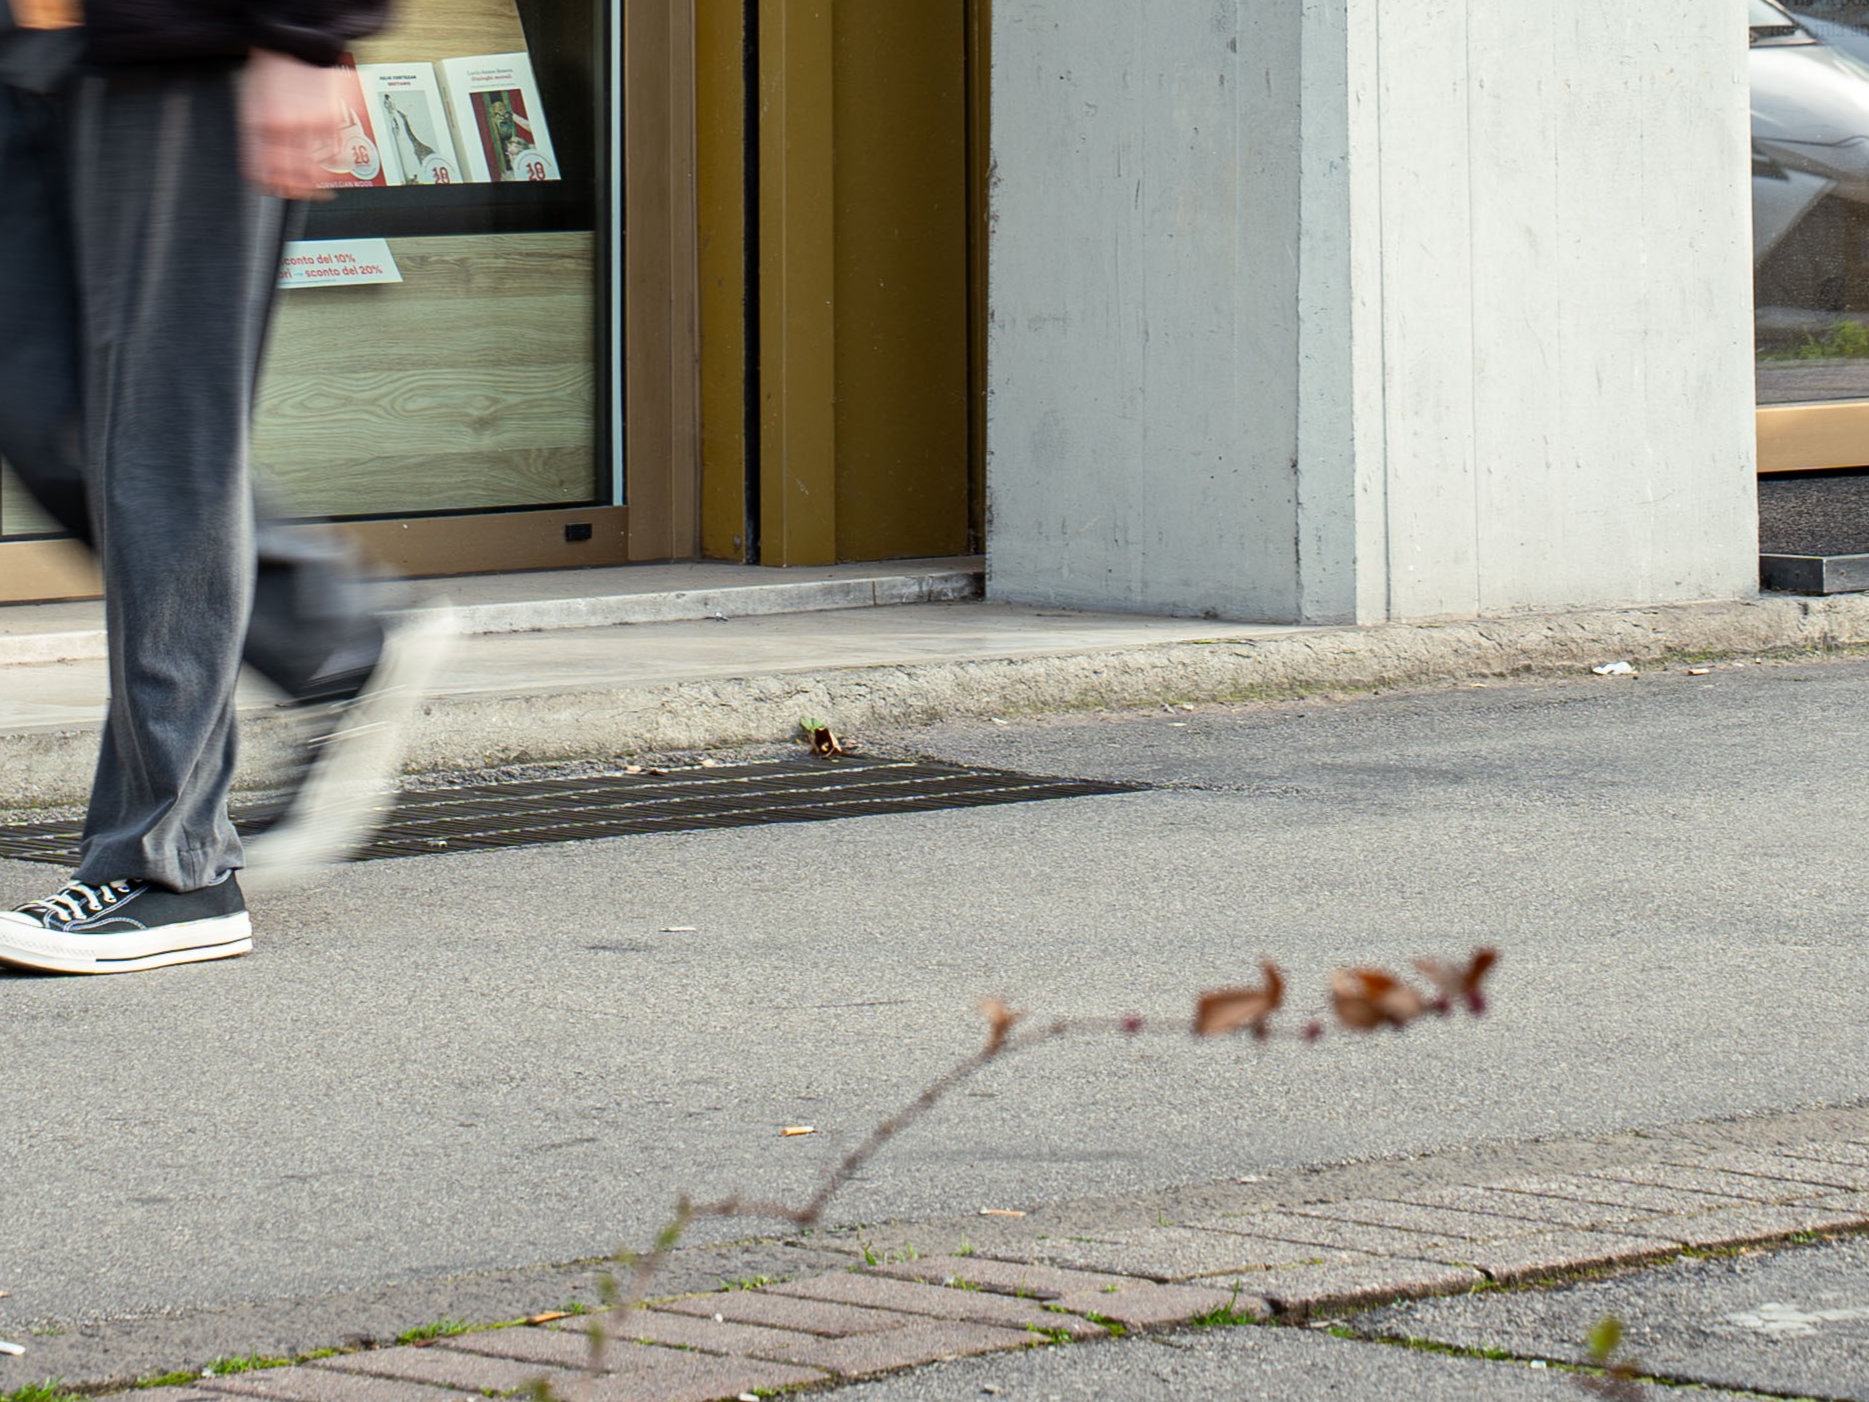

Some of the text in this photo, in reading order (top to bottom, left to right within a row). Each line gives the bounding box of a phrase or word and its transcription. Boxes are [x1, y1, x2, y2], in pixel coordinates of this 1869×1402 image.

[316, 253, 333, 265] del
[334, 253, 357, 265] 10%
[304, 264, 383, 278] sconto del 20%
